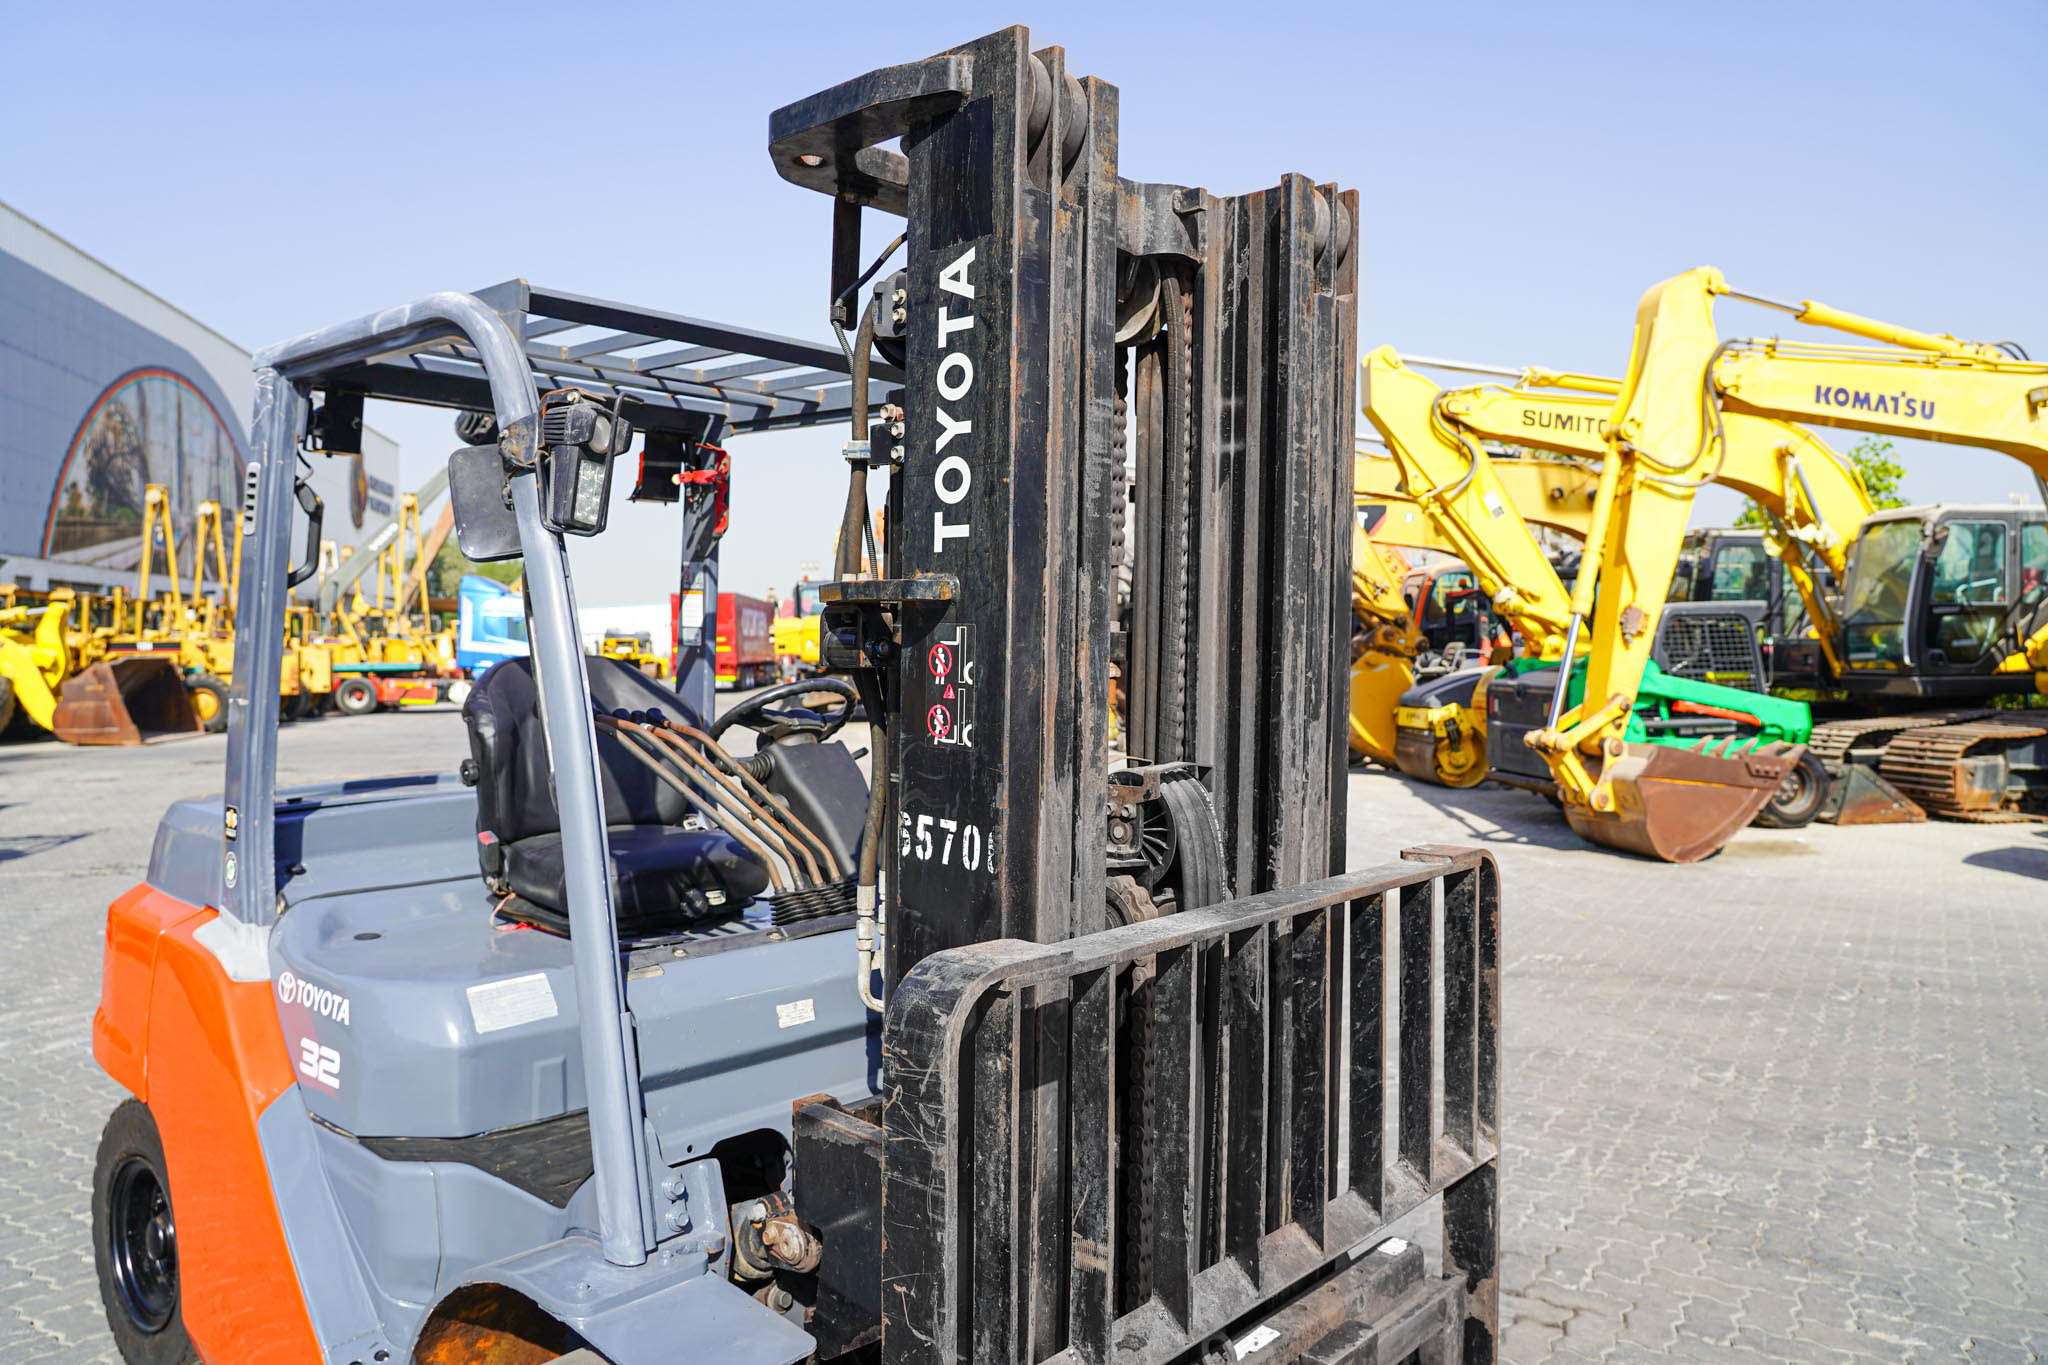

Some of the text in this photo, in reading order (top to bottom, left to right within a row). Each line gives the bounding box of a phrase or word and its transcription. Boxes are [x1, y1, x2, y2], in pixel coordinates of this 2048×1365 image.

[934, 246, 976, 553] TOYOTA
[1815, 384, 1935, 420] KOMATSU
[296, 978, 350, 1026] TOYOTA
[299, 1037, 340, 1090] 32
